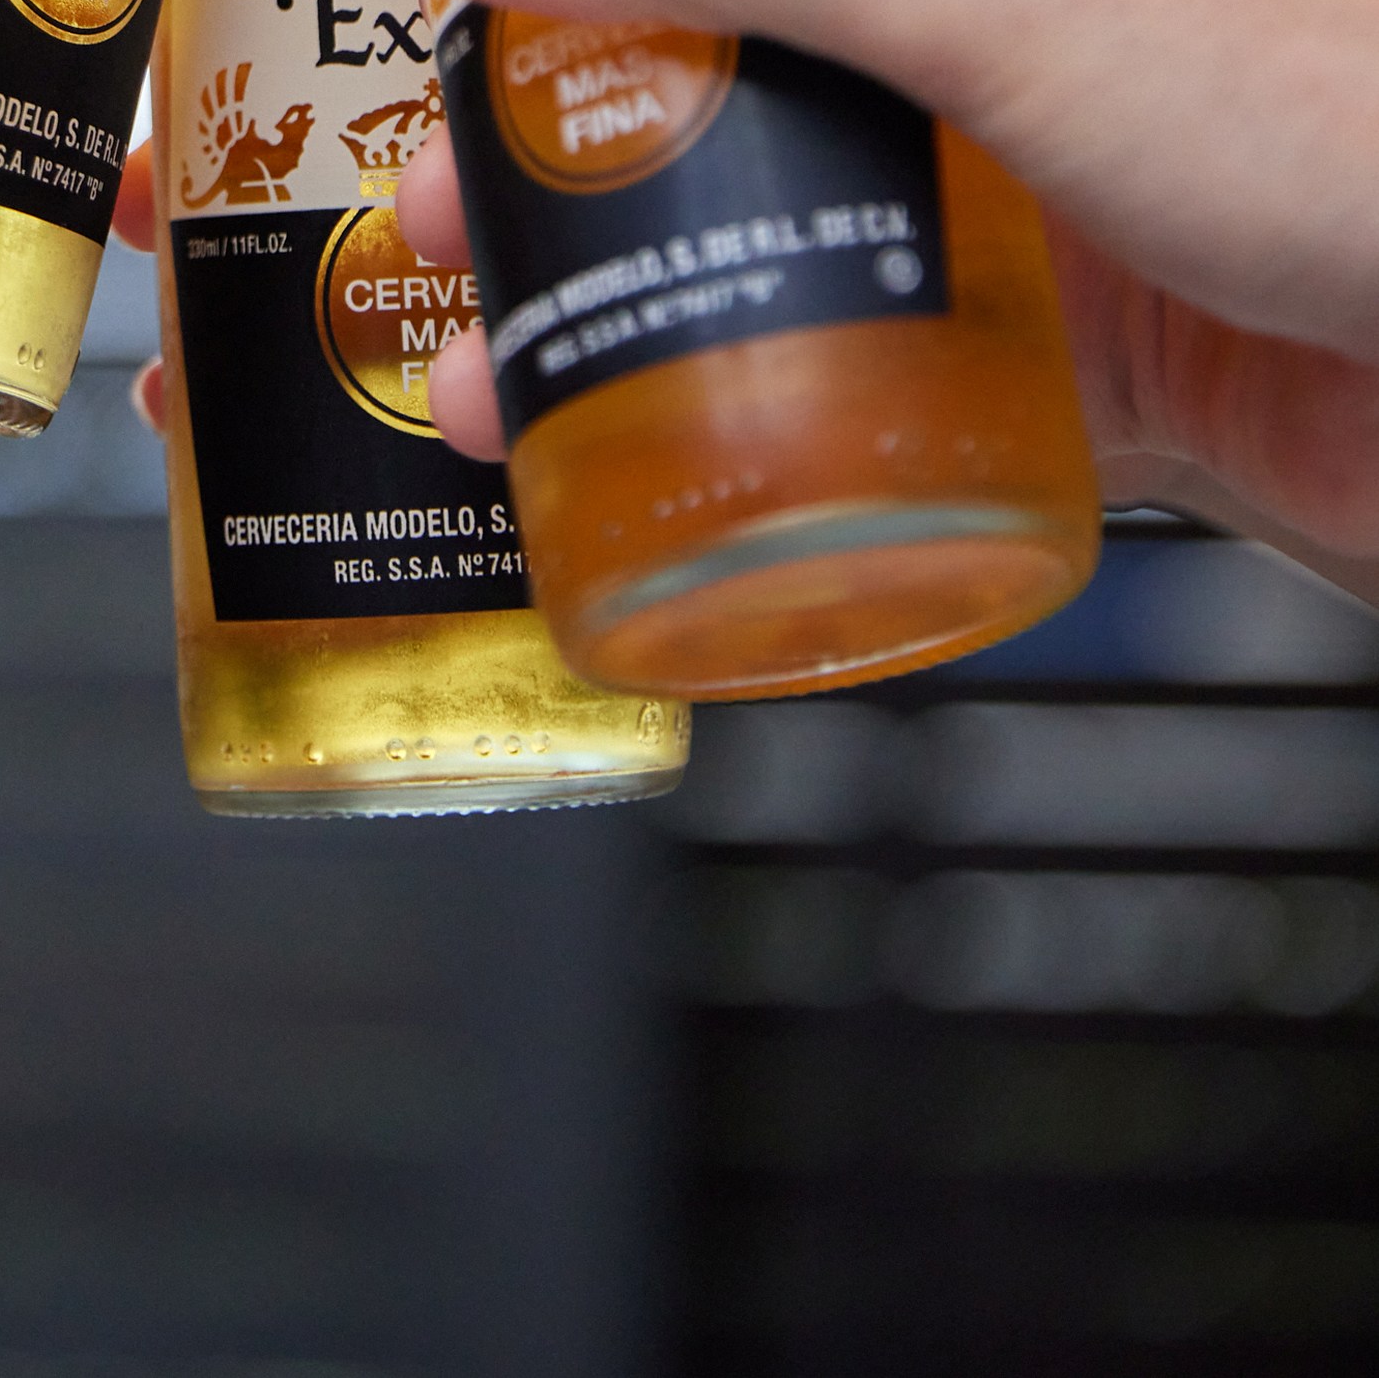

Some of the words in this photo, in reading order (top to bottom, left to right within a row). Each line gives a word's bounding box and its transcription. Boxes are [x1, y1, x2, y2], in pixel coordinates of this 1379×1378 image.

[554, 48, 656, 110] MAS
[65, 117, 81, 149] S.
[83, 124, 105, 159] DE
[558, 90, 667, 155] FINA
[52, 163, 86, 195] 7417
[344, 274, 482, 313] CERVE
[400, 315, 485, 352] MA
[224, 512, 358, 547] CERVECERIA
[365, 505, 484, 541] MODELO,
[490, 503, 516, 535] S.
[334, 558, 382, 584] REG.
[388, 555, 451, 582] S.S.A.
